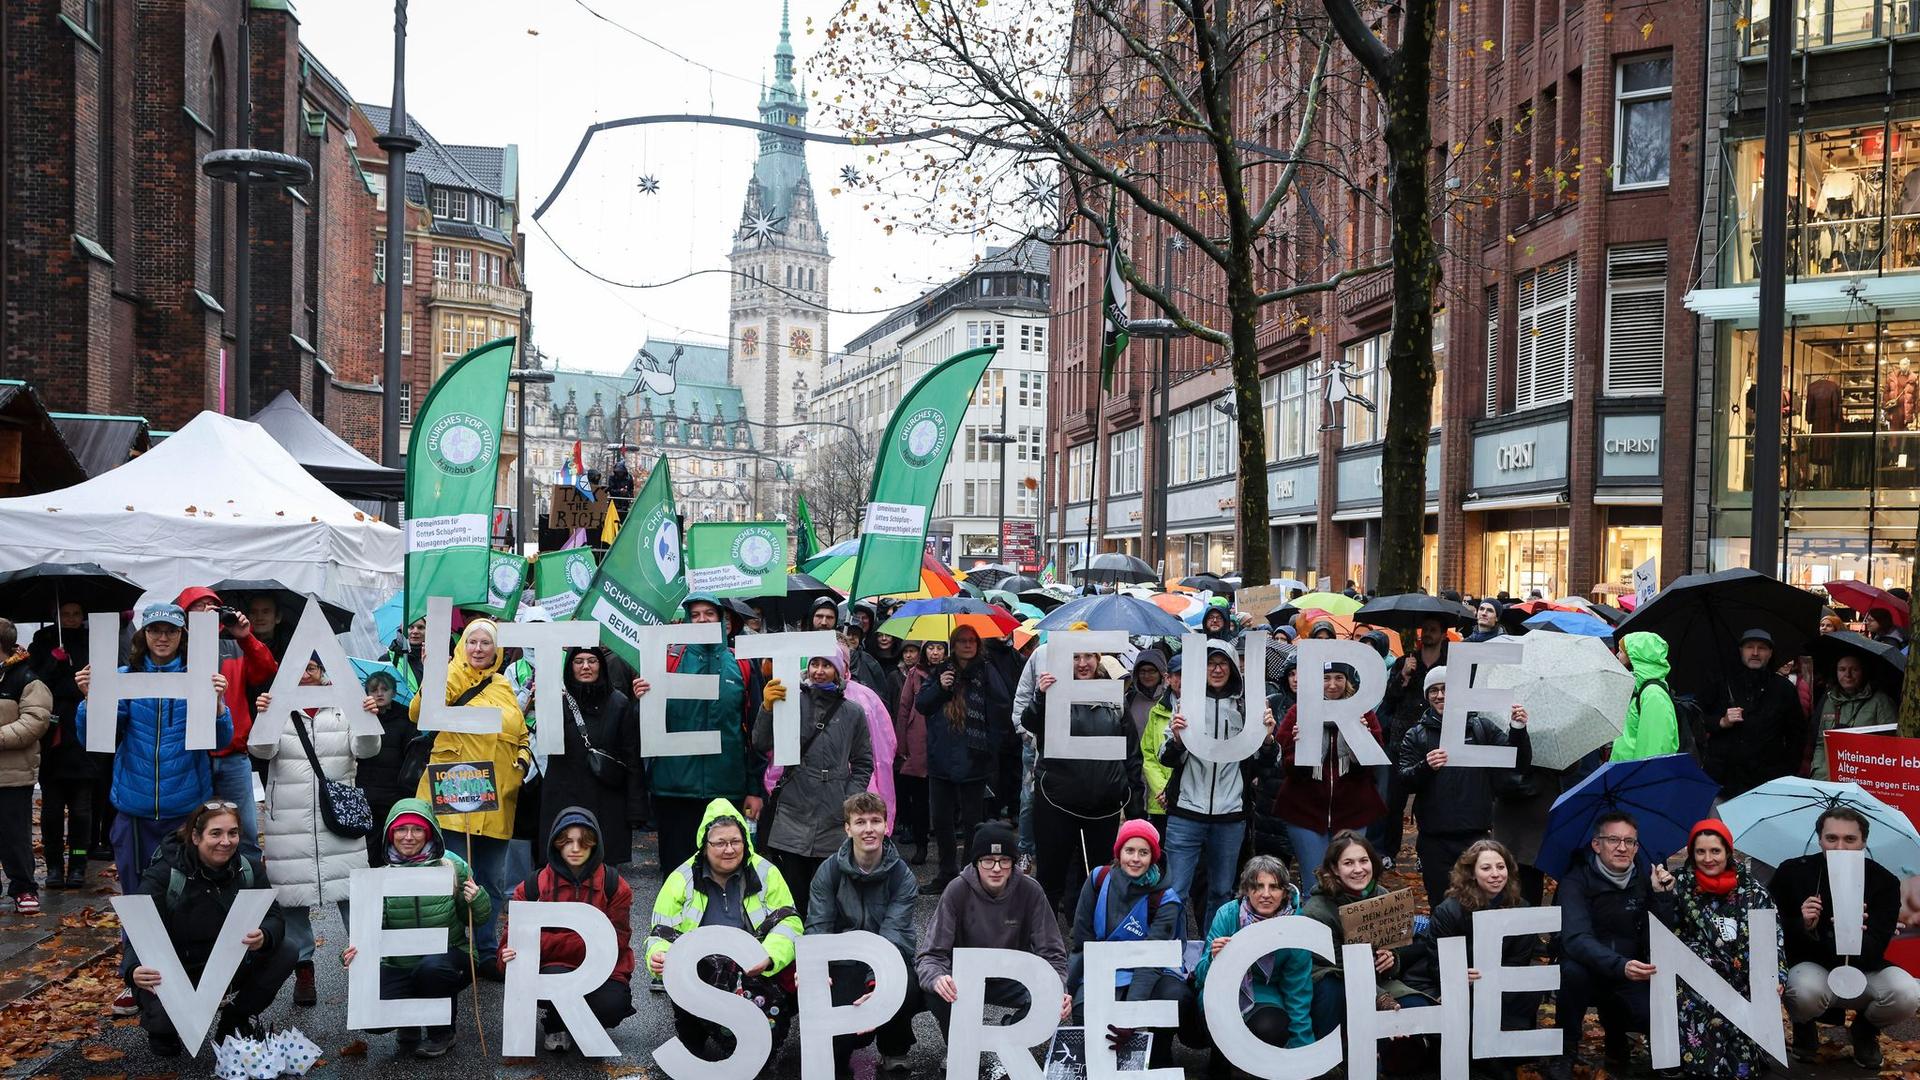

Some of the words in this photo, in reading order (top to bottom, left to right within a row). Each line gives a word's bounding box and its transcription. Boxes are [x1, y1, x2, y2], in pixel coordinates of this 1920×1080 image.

[901, 410, 931, 441] CHURCHES
[932, 410, 943, 425] FOR
[429, 415, 462, 451] CHURCHES
[464, 416, 483, 430] FOR
[479, 428, 492, 463] FUTURE
[931, 425, 946, 457] FUTURE
[1604, 437, 1657, 453] CHRIST
[1496, 441, 1535, 470] CHRIST
[436, 458, 476, 474] Hamburg
[567, 502, 588, 511] THE
[416, 519, 450, 528] Gemeinsam
[556, 511, 604, 528] RICH
[416, 529, 435, 538] Gottes
[435, 526, 467, 536] Schöpfung
[416, 536, 471, 548] Klimagerechtigkeit
[471, 536, 487, 544] jetzt!
[732, 527, 755, 558] CHURCHES
[757, 528, 772, 538] FOR
[770, 537, 781, 564] FUTURE
[738, 562, 770, 576] Hamburg
[608, 612, 640, 644] BEWA
[86, 594, 837, 766] HALTET
[1045, 631, 1523, 768] EURE
[1837, 749, 1897, 767] Miteinander
[1901, 755, 1920, 768] leb
[436, 770, 456, 781] ICH
[459, 768, 490, 780] HABE
[1837, 762, 1859, 774] Alter
[434, 779, 495, 796] KLIMA
[1837, 774, 1873, 787] Gemeinsam
[1875, 779, 1900, 790] gegen
[1902, 782, 1920, 791] Eins
[435, 792, 496, 805] SCHMERZEN
[1346, 903, 1365, 915] DAS
[1370, 897, 1385, 908] IST
[1394, 889, 1414, 902] NICHT
[1362, 911, 1381, 922] MEIN
[1383, 903, 1405, 915] LAND
[1126, 925, 1144, 937] NABU
[1357, 922, 1376, 933] ODER
[1379, 917, 1394, 926] DEIN
[1370, 929, 1382, 939] IST
[1385, 921, 1412, 935] UNSER
